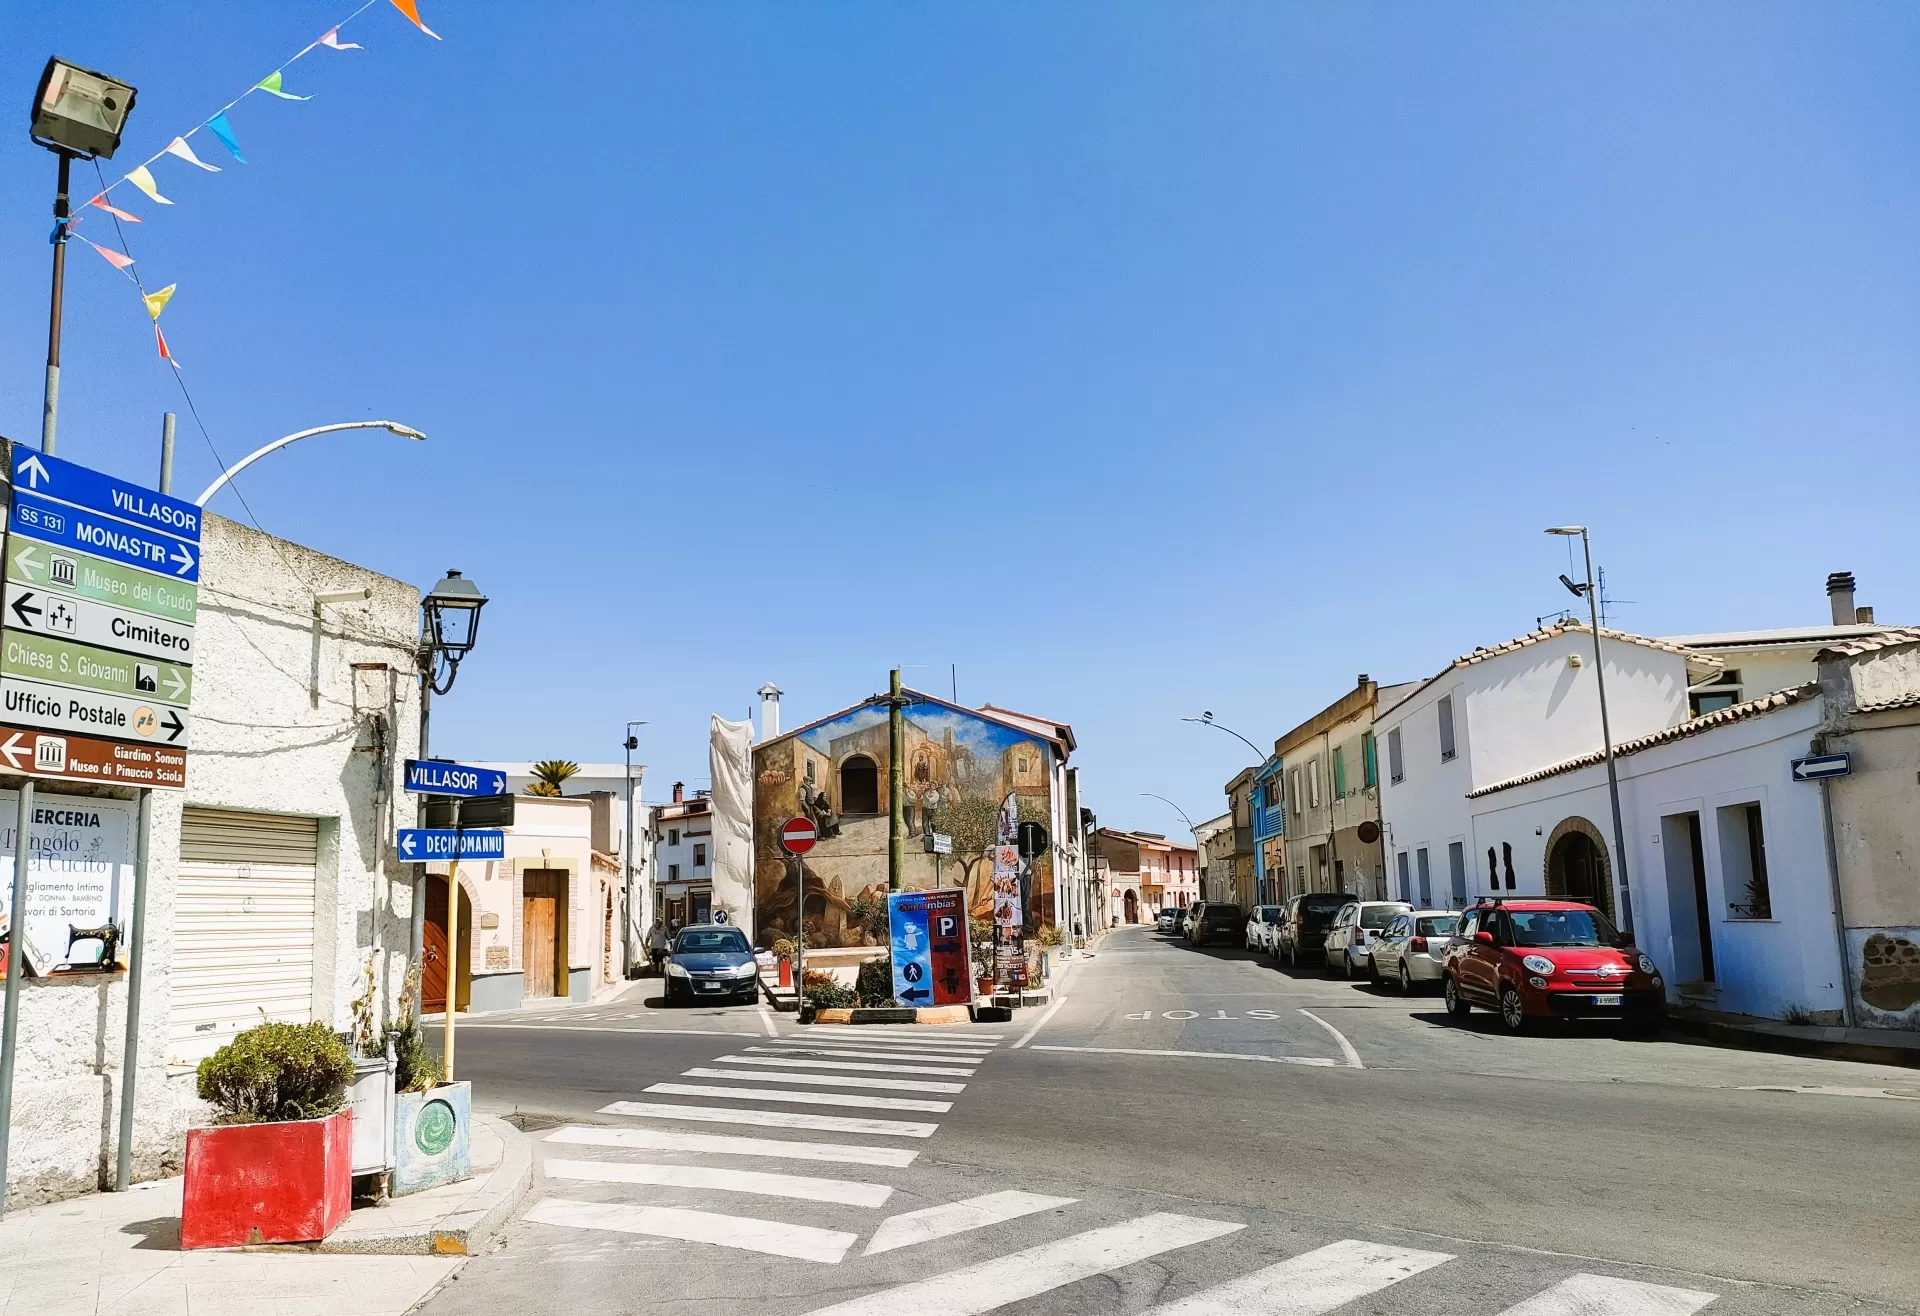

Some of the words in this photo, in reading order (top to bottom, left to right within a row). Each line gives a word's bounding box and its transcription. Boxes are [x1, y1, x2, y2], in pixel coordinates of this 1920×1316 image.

[112, 489, 196, 531] VILLASOR
[21, 508, 38, 523] SS
[43, 515, 62, 530] 131
[76, 522, 166, 564] MONASTIR
[84, 568, 127, 596] Museo
[133, 582, 151, 601] del
[157, 588, 193, 612] Crudo
[111, 617, 190, 651] Cimitero
[7, 642, 53, 670] Chiesa
[59, 653, 71, 673] S.
[77, 656, 129, 683] Giovanni
[5, 690, 61, 717] Ufficio
[69, 700, 126, 727] Postale
[114, 746, 151, 762] Giardino
[155, 751, 183, 766] Sonoro
[69, 758, 99, 774] Museo
[103, 763, 112, 775] di
[116, 764, 153, 780] Pinuccio
[156, 769, 183, 783] Sciola
[409, 766, 478, 790] VILLASOR
[1, 827, 79, 857] l'ngolo
[426, 835, 502, 853] DECIMOMANNU
[49, 852, 106, 873] Cucito
[7, 881, 74, 893] Aigliamento
[77, 882, 104, 892] Intimo
[39, 894, 65, 904] DONNA
[73, 895, 102, 904] BAMBINO
[49, 906, 57, 916] di
[60, 907, 96, 916] Sartoria
[940, 917, 954, 936] P
[1124, 1009, 1282, 1020] STOP
